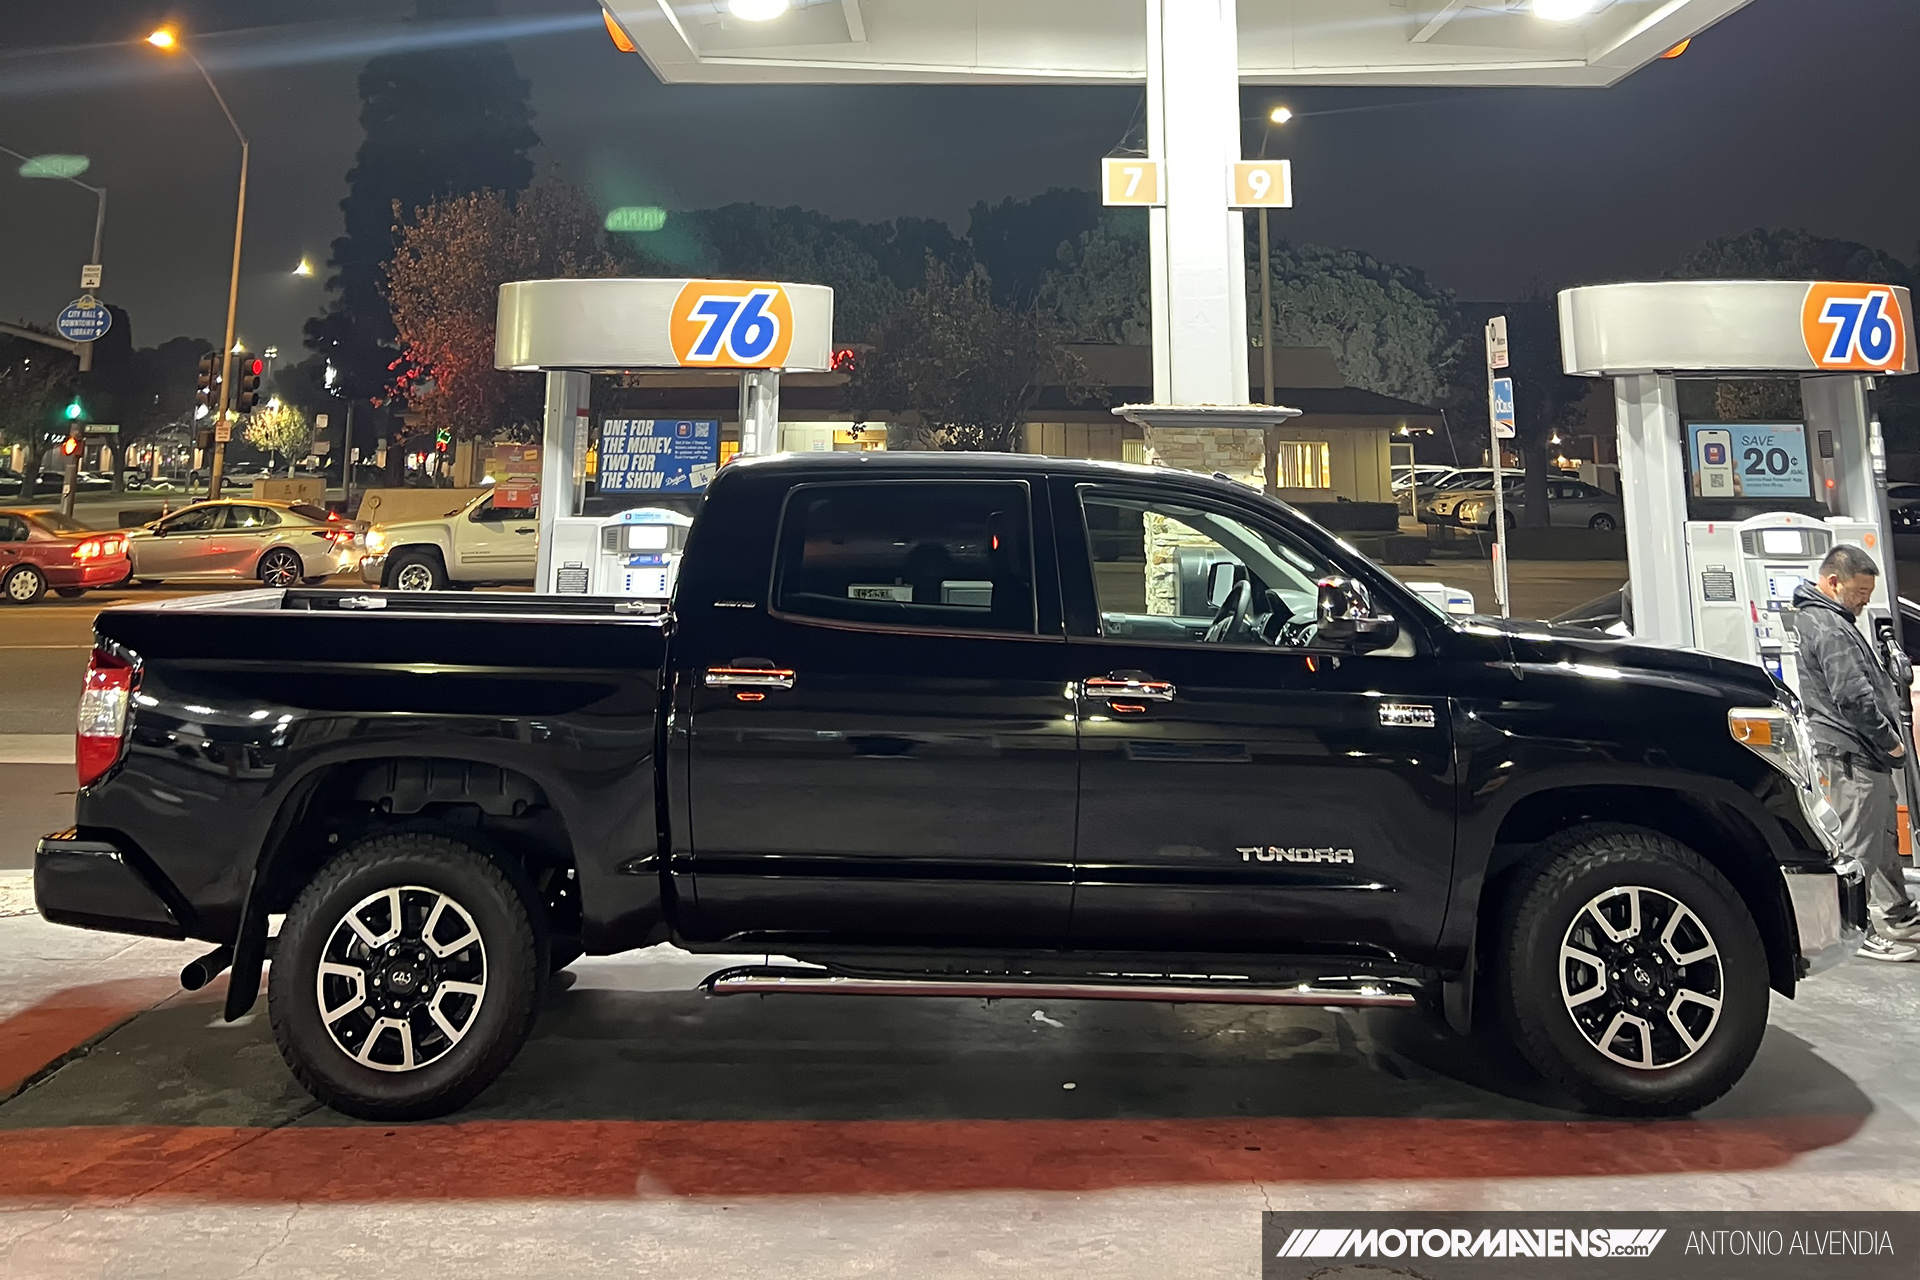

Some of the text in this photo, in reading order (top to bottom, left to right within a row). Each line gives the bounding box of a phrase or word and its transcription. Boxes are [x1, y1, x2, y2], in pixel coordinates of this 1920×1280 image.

[1123, 167, 1143, 197] 7
[1247, 169, 1271, 199] 9
[67, 310, 96, 318] CITY HALL
[61, 319, 96, 327] DOWNTOWN
[686, 288, 780, 364] 76
[1818, 291, 1896, 366] 76
[69, 328, 95, 336] LIBRARY
[602, 420, 655, 436] ONE FOR
[602, 437, 672, 455] THE MONEY,
[1741, 436, 1775, 446] SAVE
[602, 454, 656, 471] TWO FOR
[601, 472, 664, 489] THE SHOW
[1236, 846, 1354, 864] TUNDRA
